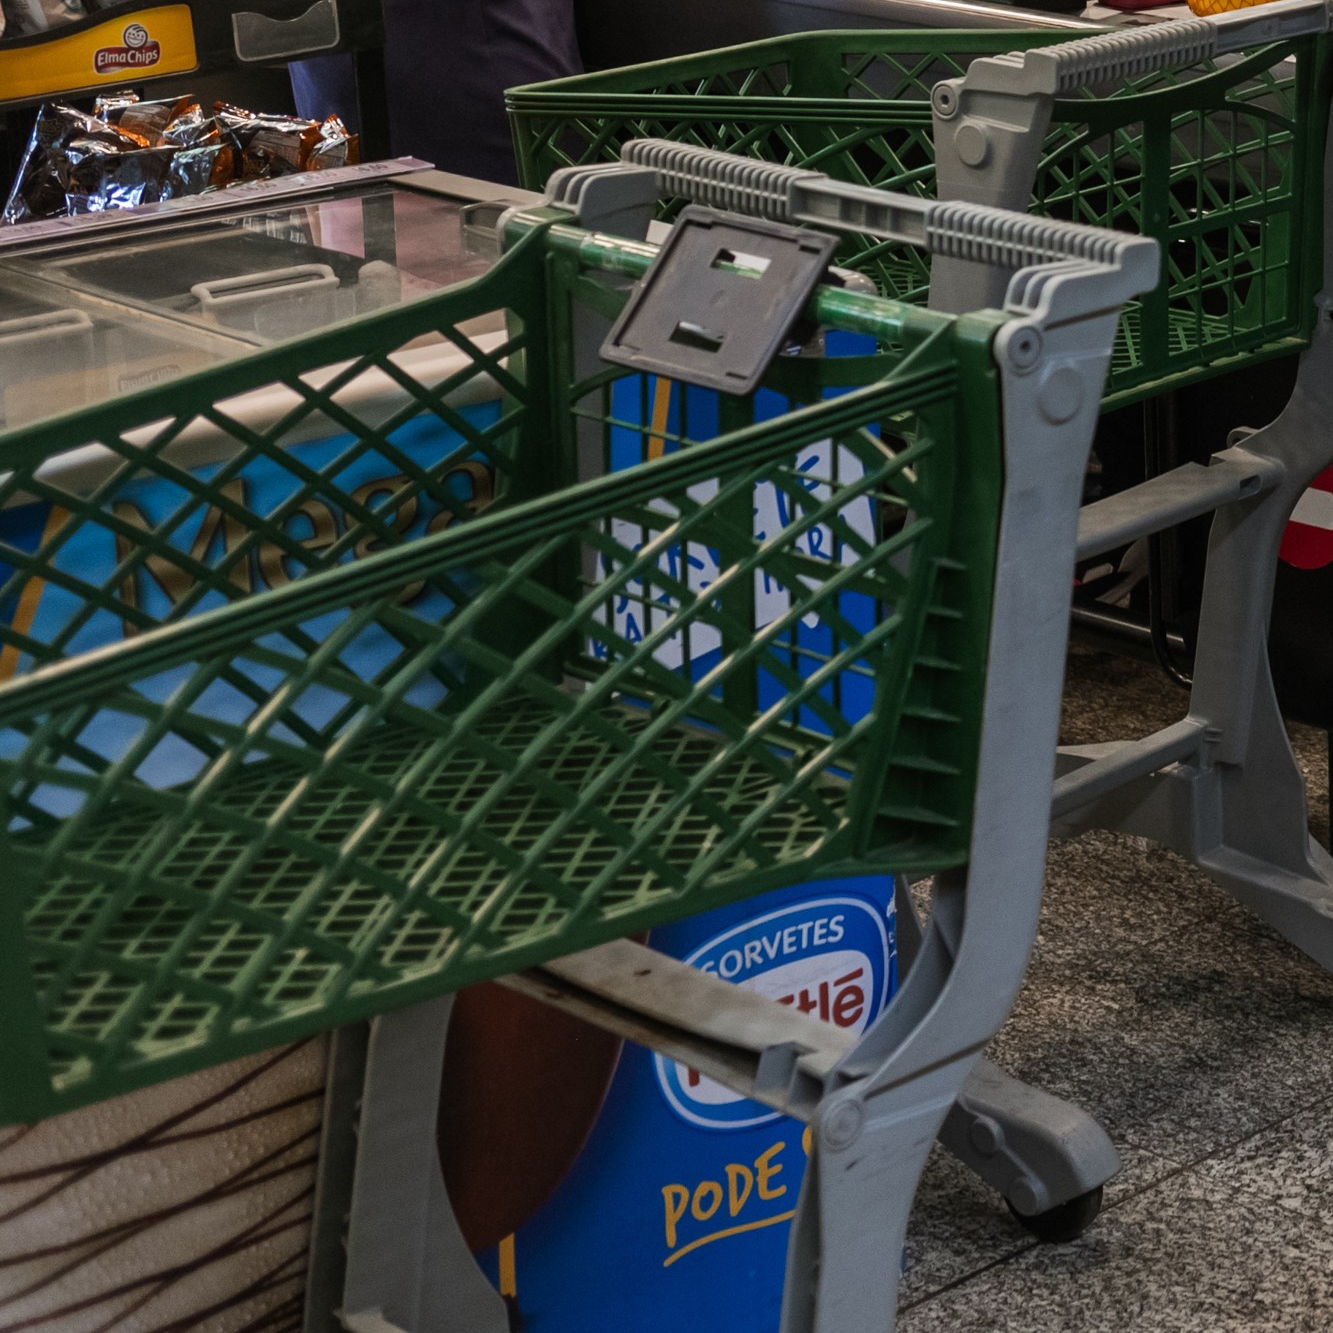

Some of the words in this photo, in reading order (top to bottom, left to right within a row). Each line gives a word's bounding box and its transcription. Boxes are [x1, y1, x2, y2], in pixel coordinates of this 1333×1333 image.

[97, 50, 126, 66] Elma
[127, 49, 158, 64] Chips
[776, 967, 864, 1028] tlé
[662, 1141, 787, 1248] PODE
